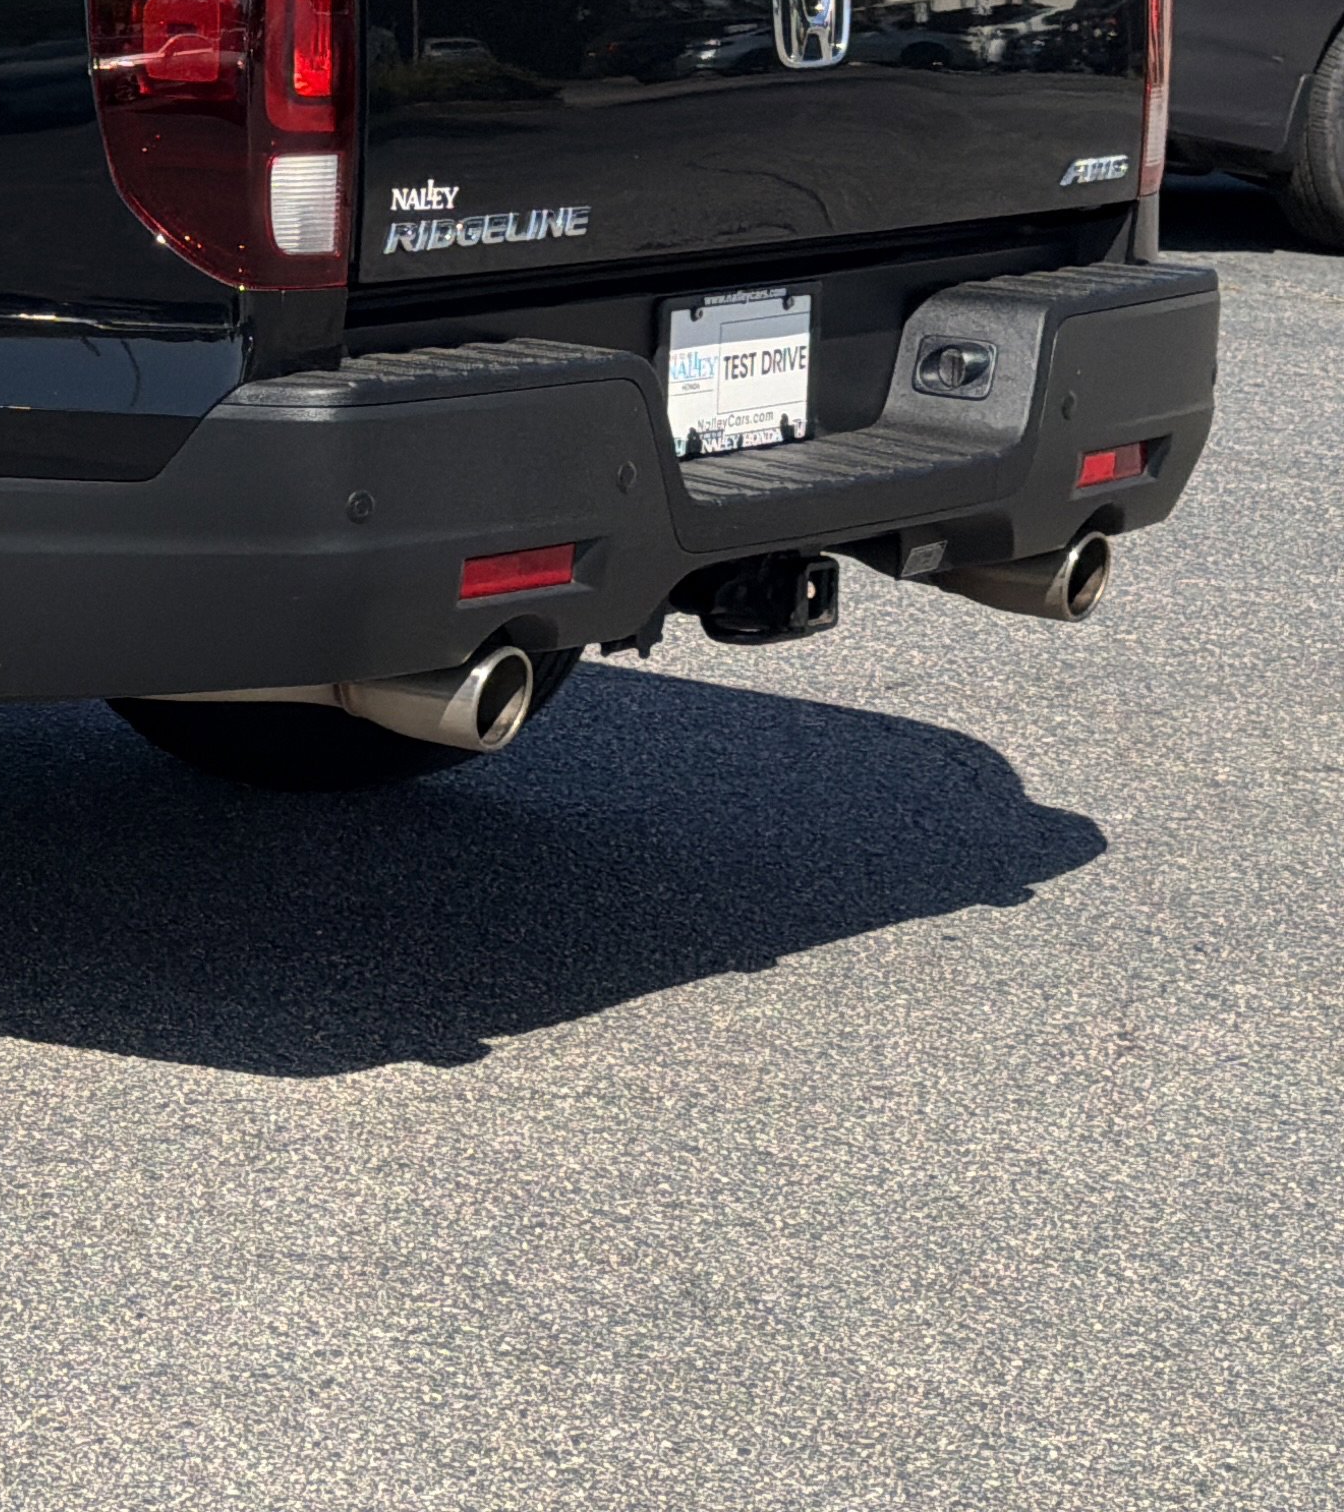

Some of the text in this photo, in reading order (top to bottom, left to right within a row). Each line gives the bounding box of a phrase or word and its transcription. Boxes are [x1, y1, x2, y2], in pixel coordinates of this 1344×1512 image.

[390, 179, 460, 210] NALLEY
[383, 205, 592, 255] RIDGELINE
[723, 345, 807, 381] TEST DRIVE
[697, 411, 774, 433] NalleyCars.com
